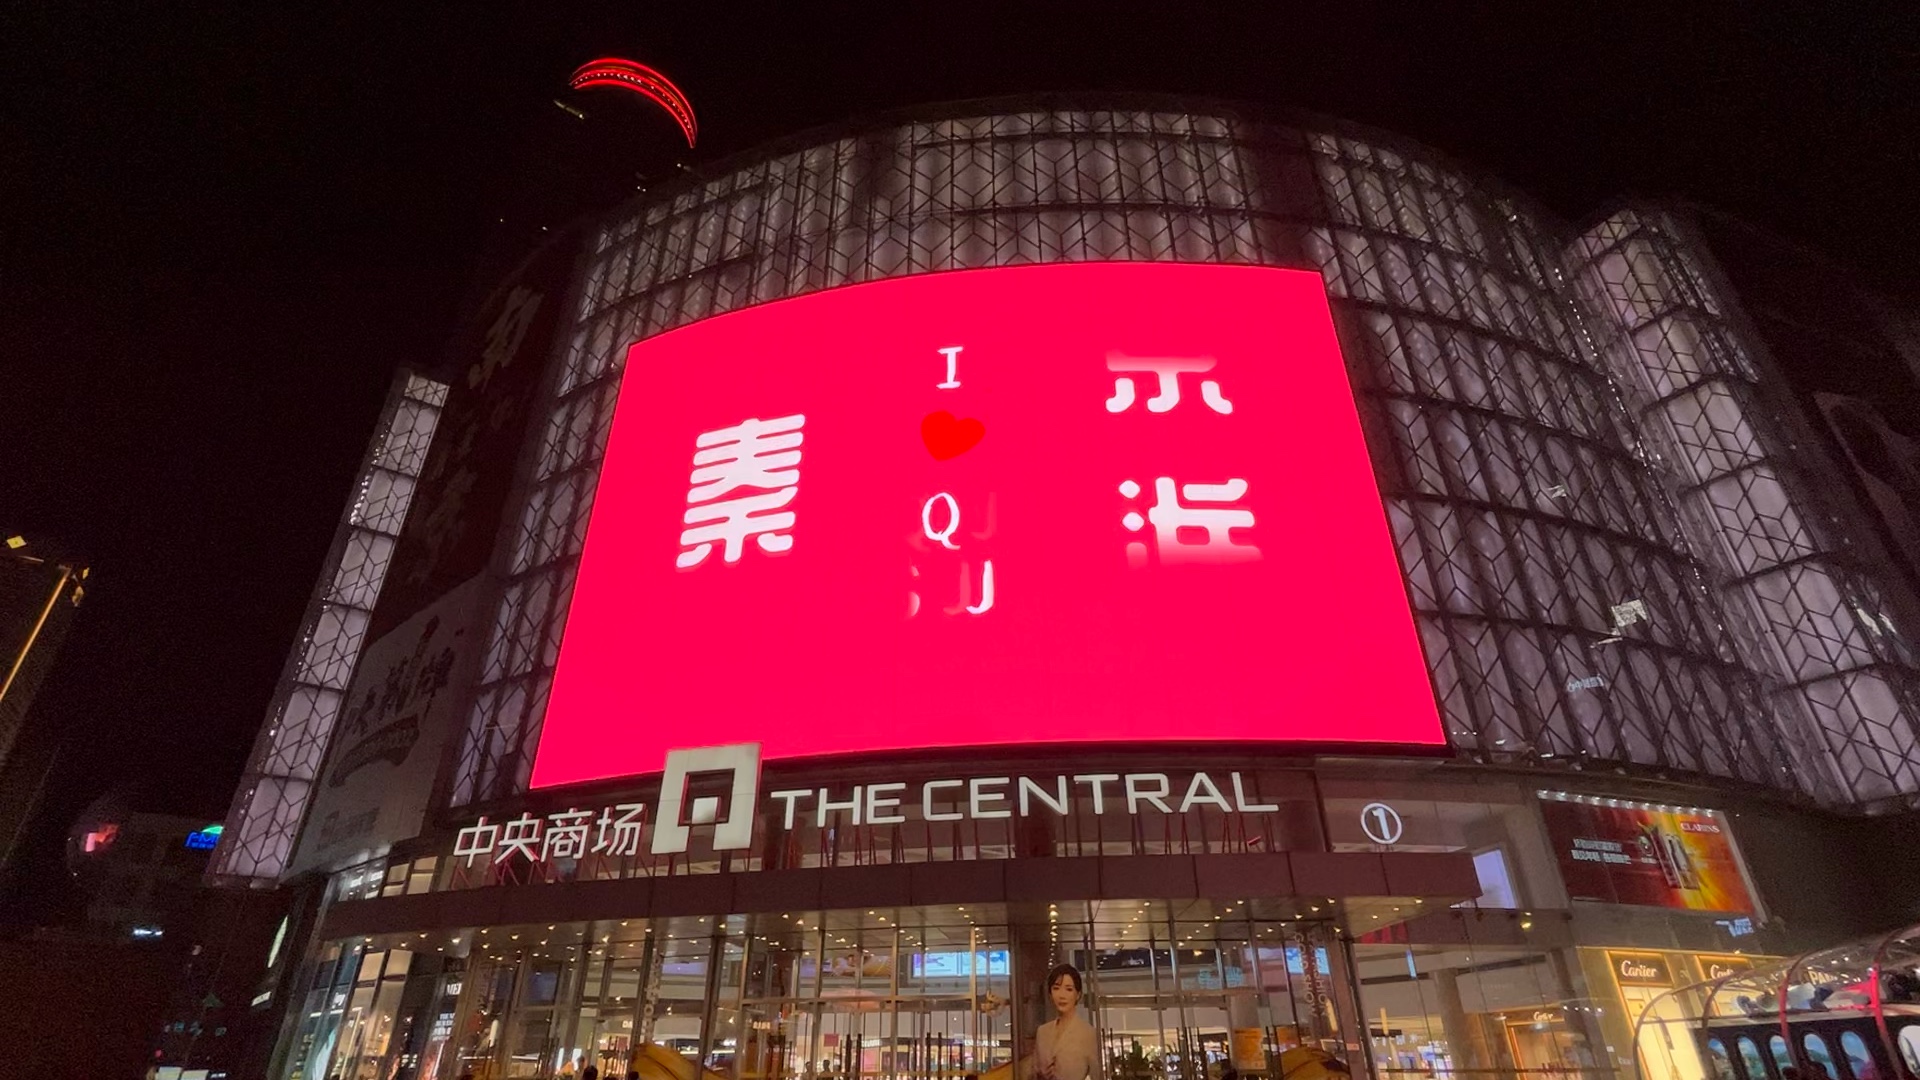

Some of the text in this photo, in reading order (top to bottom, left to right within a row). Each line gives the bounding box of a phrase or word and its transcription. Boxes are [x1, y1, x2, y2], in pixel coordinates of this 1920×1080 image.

[936, 345, 964, 390] I
[921, 492, 962, 550] Q
[770, 771, 1280, 831] THE CENTRAL
[453, 803, 647, 869] 中央商场
[1620, 959, 1658, 978] Cartier
